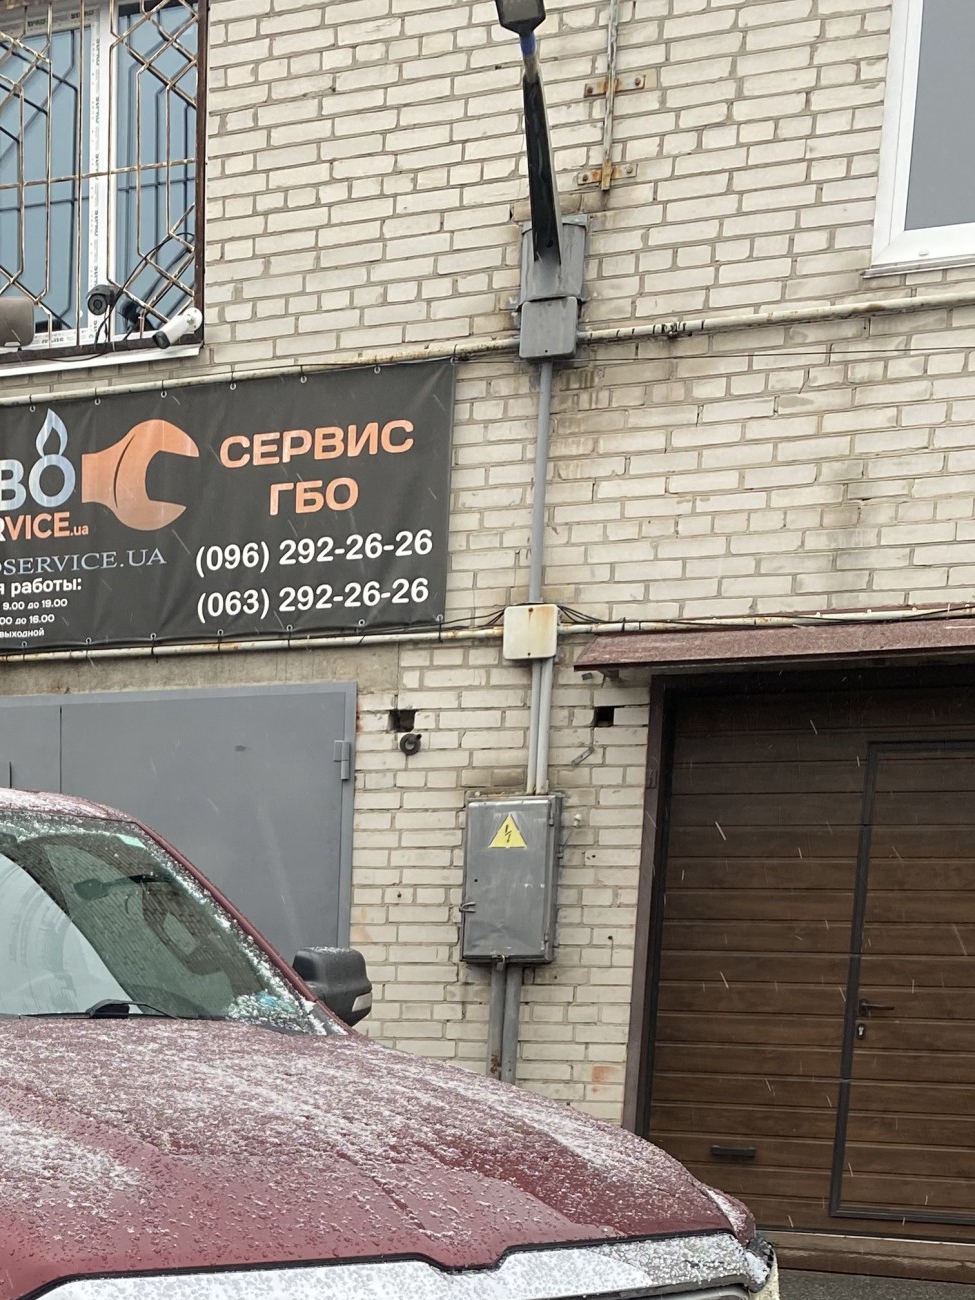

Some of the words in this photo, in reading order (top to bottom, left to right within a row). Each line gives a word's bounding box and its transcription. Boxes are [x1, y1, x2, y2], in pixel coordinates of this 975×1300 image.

[219, 419, 414, 469] СЕРВИС
[269, 477, 359, 516] ГБО
[195, 541, 270, 578] (096)
[278, 529, 433, 566] 292-26-26
[2, 601, 25, 611] 9.00
[27, 602, 40, 611] до
[41, 598, 68, 608] 19.00
[11, 578, 82, 598] работы:
[197, 588, 270, 624] (063)
[278, 577, 429, 612] 292-26-26
[14, 617, 27, 626] до
